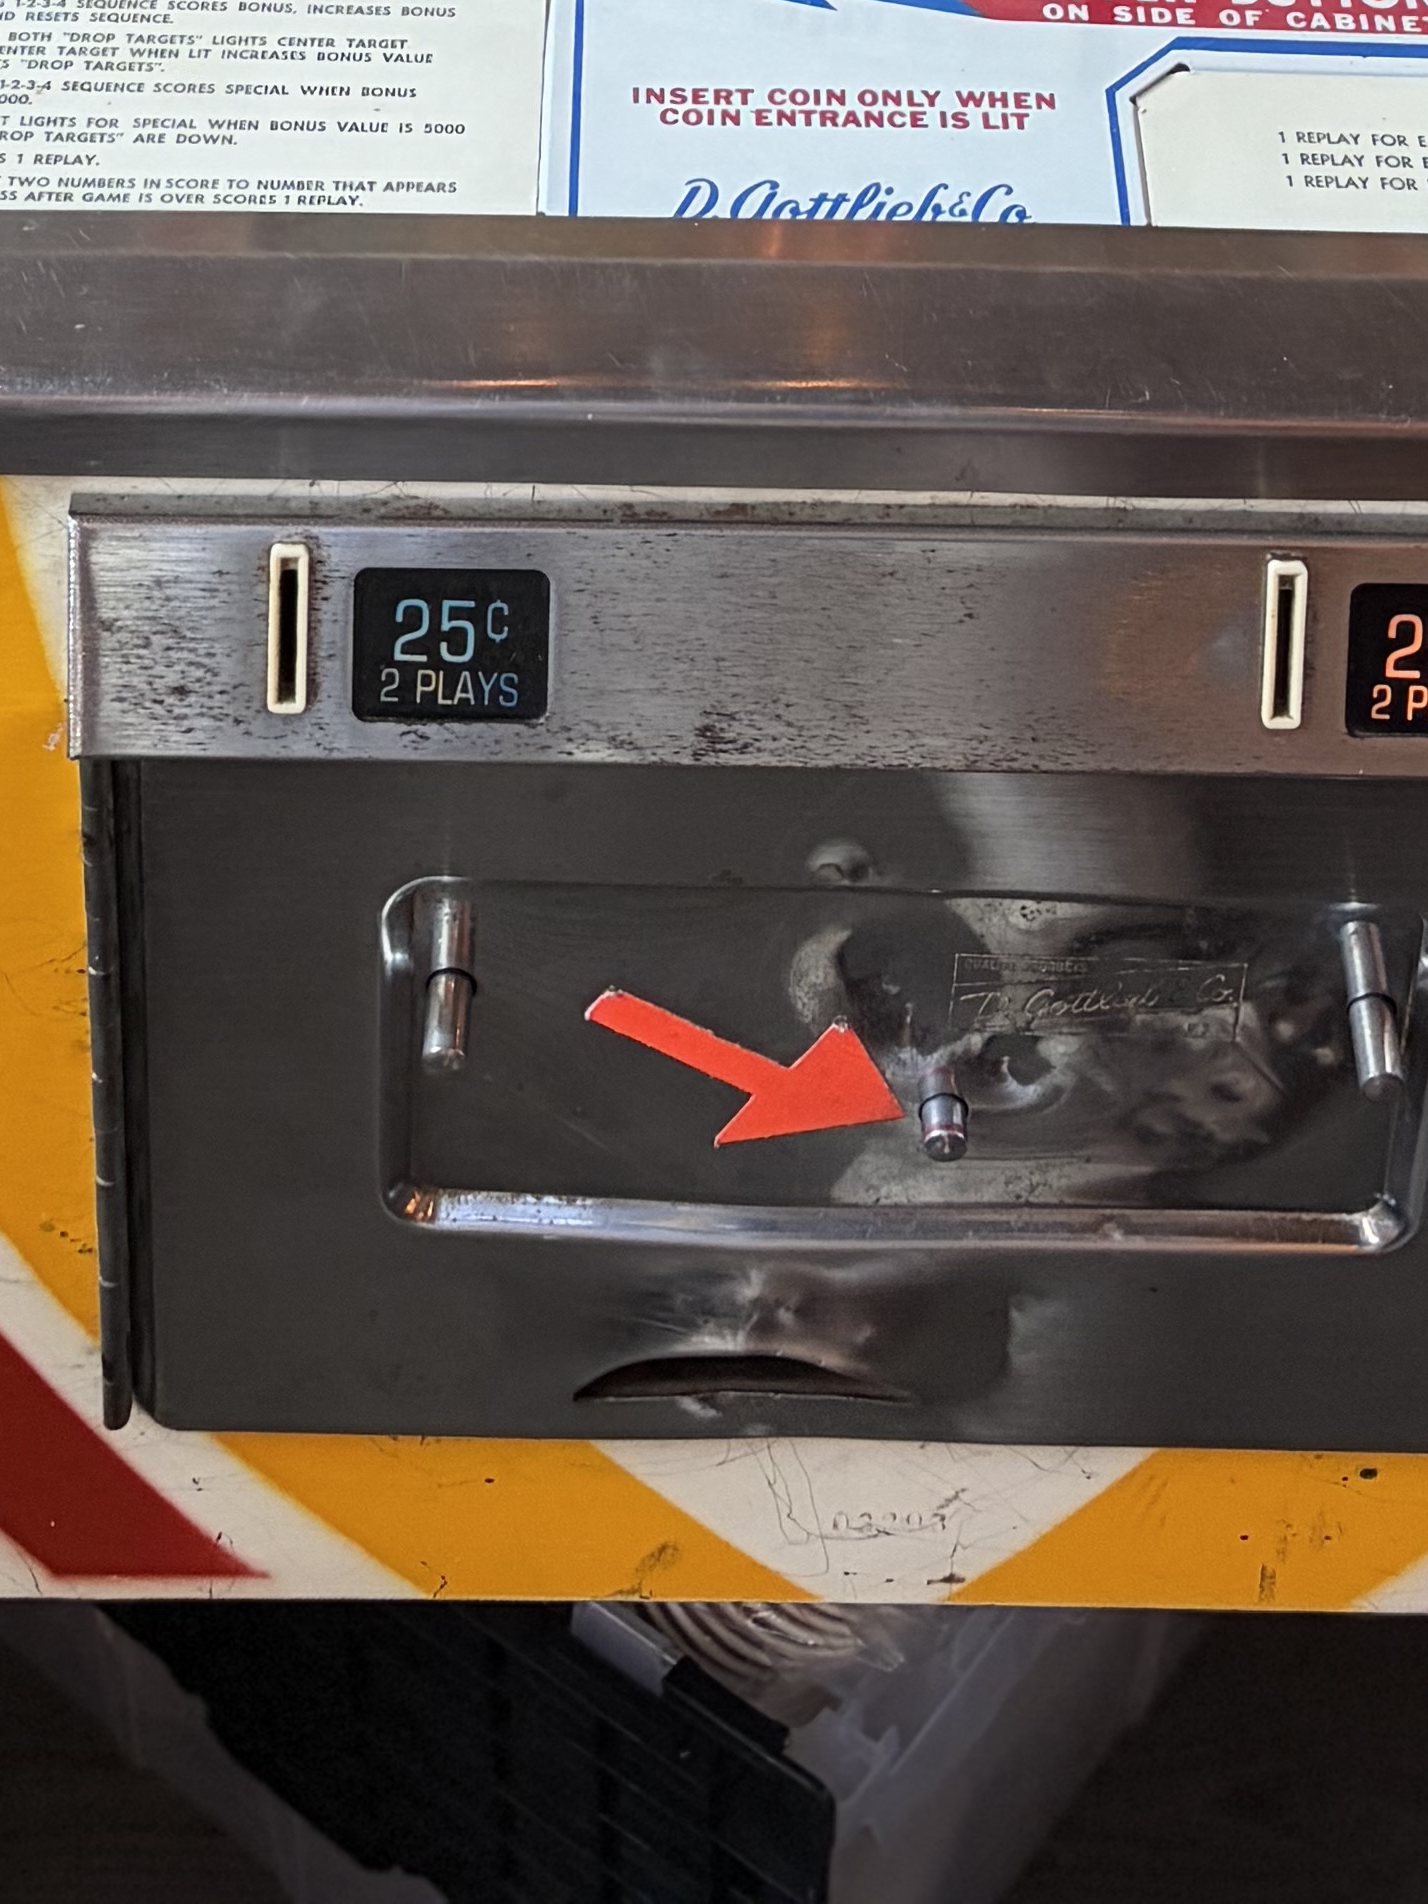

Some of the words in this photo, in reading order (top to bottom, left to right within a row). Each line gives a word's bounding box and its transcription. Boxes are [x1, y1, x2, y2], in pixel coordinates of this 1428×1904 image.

[25, 11, 80, 22] RESETS
[76, 0, 158, 10] SEQUENCE
[167, 0, 228, 12] SCORES
[237, 1, 298, 15] BONUS,
[307, 4, 392, 16] INCREASES
[401, 6, 457, 18] BONUS
[1042, 4, 1089, 21] ON
[1114, 6, 1195, 25] SIDE
[1219, 9, 1261, 27] OF
[632, 87, 754, 105] INSERT
[768, 89, 846, 106] COIN
[858, 90, 941, 107] ONLY
[955, 90, 1056, 110] WHEN
[660, 108, 740, 126] COIN
[754, 109, 929, 128] ENTRANCE
[940, 111, 970, 129] IS
[982, 112, 1030, 130] LIT
[1278, 131, 1287, 143] 1
[1296, 132, 1360, 145] REPLAY
[1371, 133, 1409, 147] FOR
[17, 153, 23, 164] 1
[33, 154, 100, 166] REPLAY.
[1282, 152, 1290, 165] 1
[1300, 153, 1365, 168] REPLAY
[1376, 155, 1414, 169] FOR
[1286, 175, 1294, 188] 1
[1304, 176, 1369, 190] REPLAY
[1380, 178, 1418, 192] FOR
[24, 190, 74, 202] AFTER
[82, 192, 130, 203] GAME
[138, 192, 153, 203] IS
[160, 193, 205, 204] OVER
[212, 194, 277, 205] SCORES
[284, 195, 290, 205] 1
[297, 195, 364, 207] REPLAY.
[394, 598, 509, 663] 25¢
[380, 667, 400, 702] 2
[416, 669, 519, 707] PLAYS
[1371, 683, 1392, 720] 2
